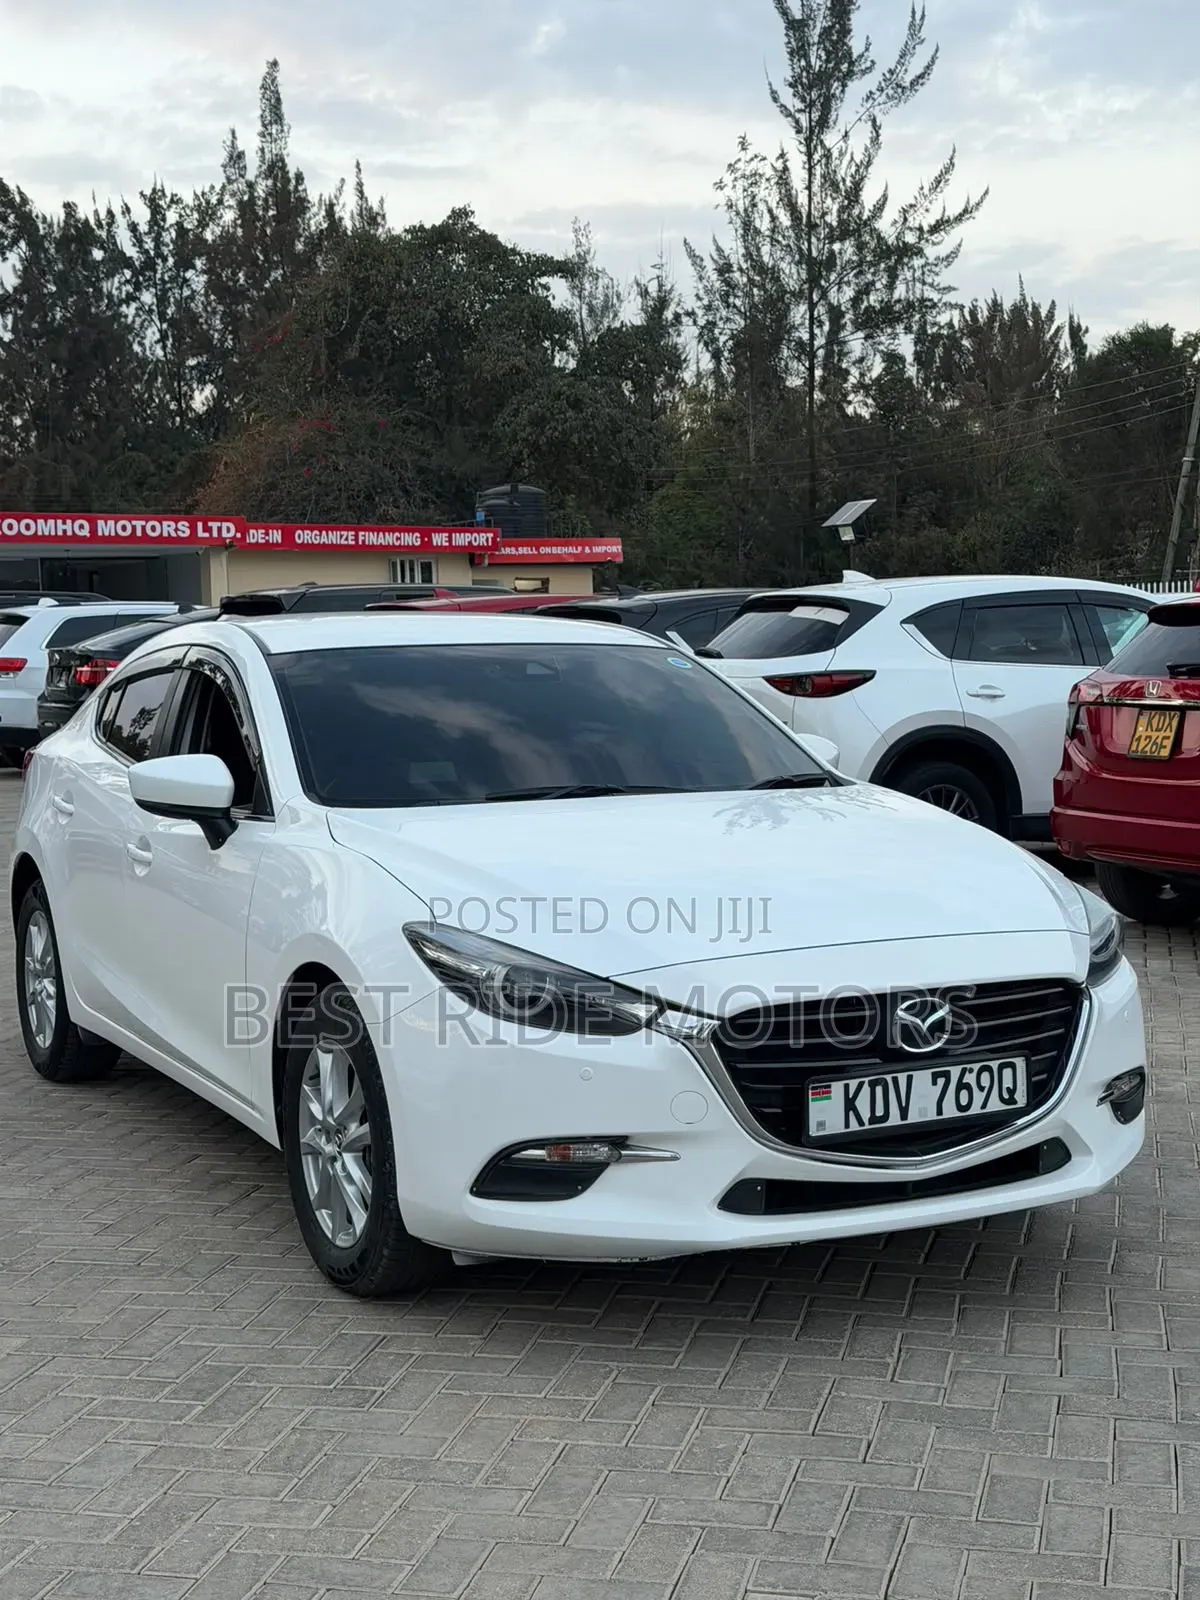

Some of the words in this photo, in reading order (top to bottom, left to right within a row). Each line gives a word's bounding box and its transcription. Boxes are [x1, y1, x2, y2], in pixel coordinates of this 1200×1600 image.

[0, 518, 90, 537] OOMHQ
[97, 519, 190, 538] MOTORS
[197, 521, 241, 538] LTD.
[295, 529, 355, 545] ORGANIZE
[358, 531, 421, 546] FINANCING
[431, 533, 449, 546] WE
[452, 533, 493, 546] IMPORT
[1145, 711, 1178, 733] KDX
[1131, 735, 1171, 756] 126F
[843, 1073, 914, 1130] KDV
[931, 1060, 1018, 1117] 769Q
